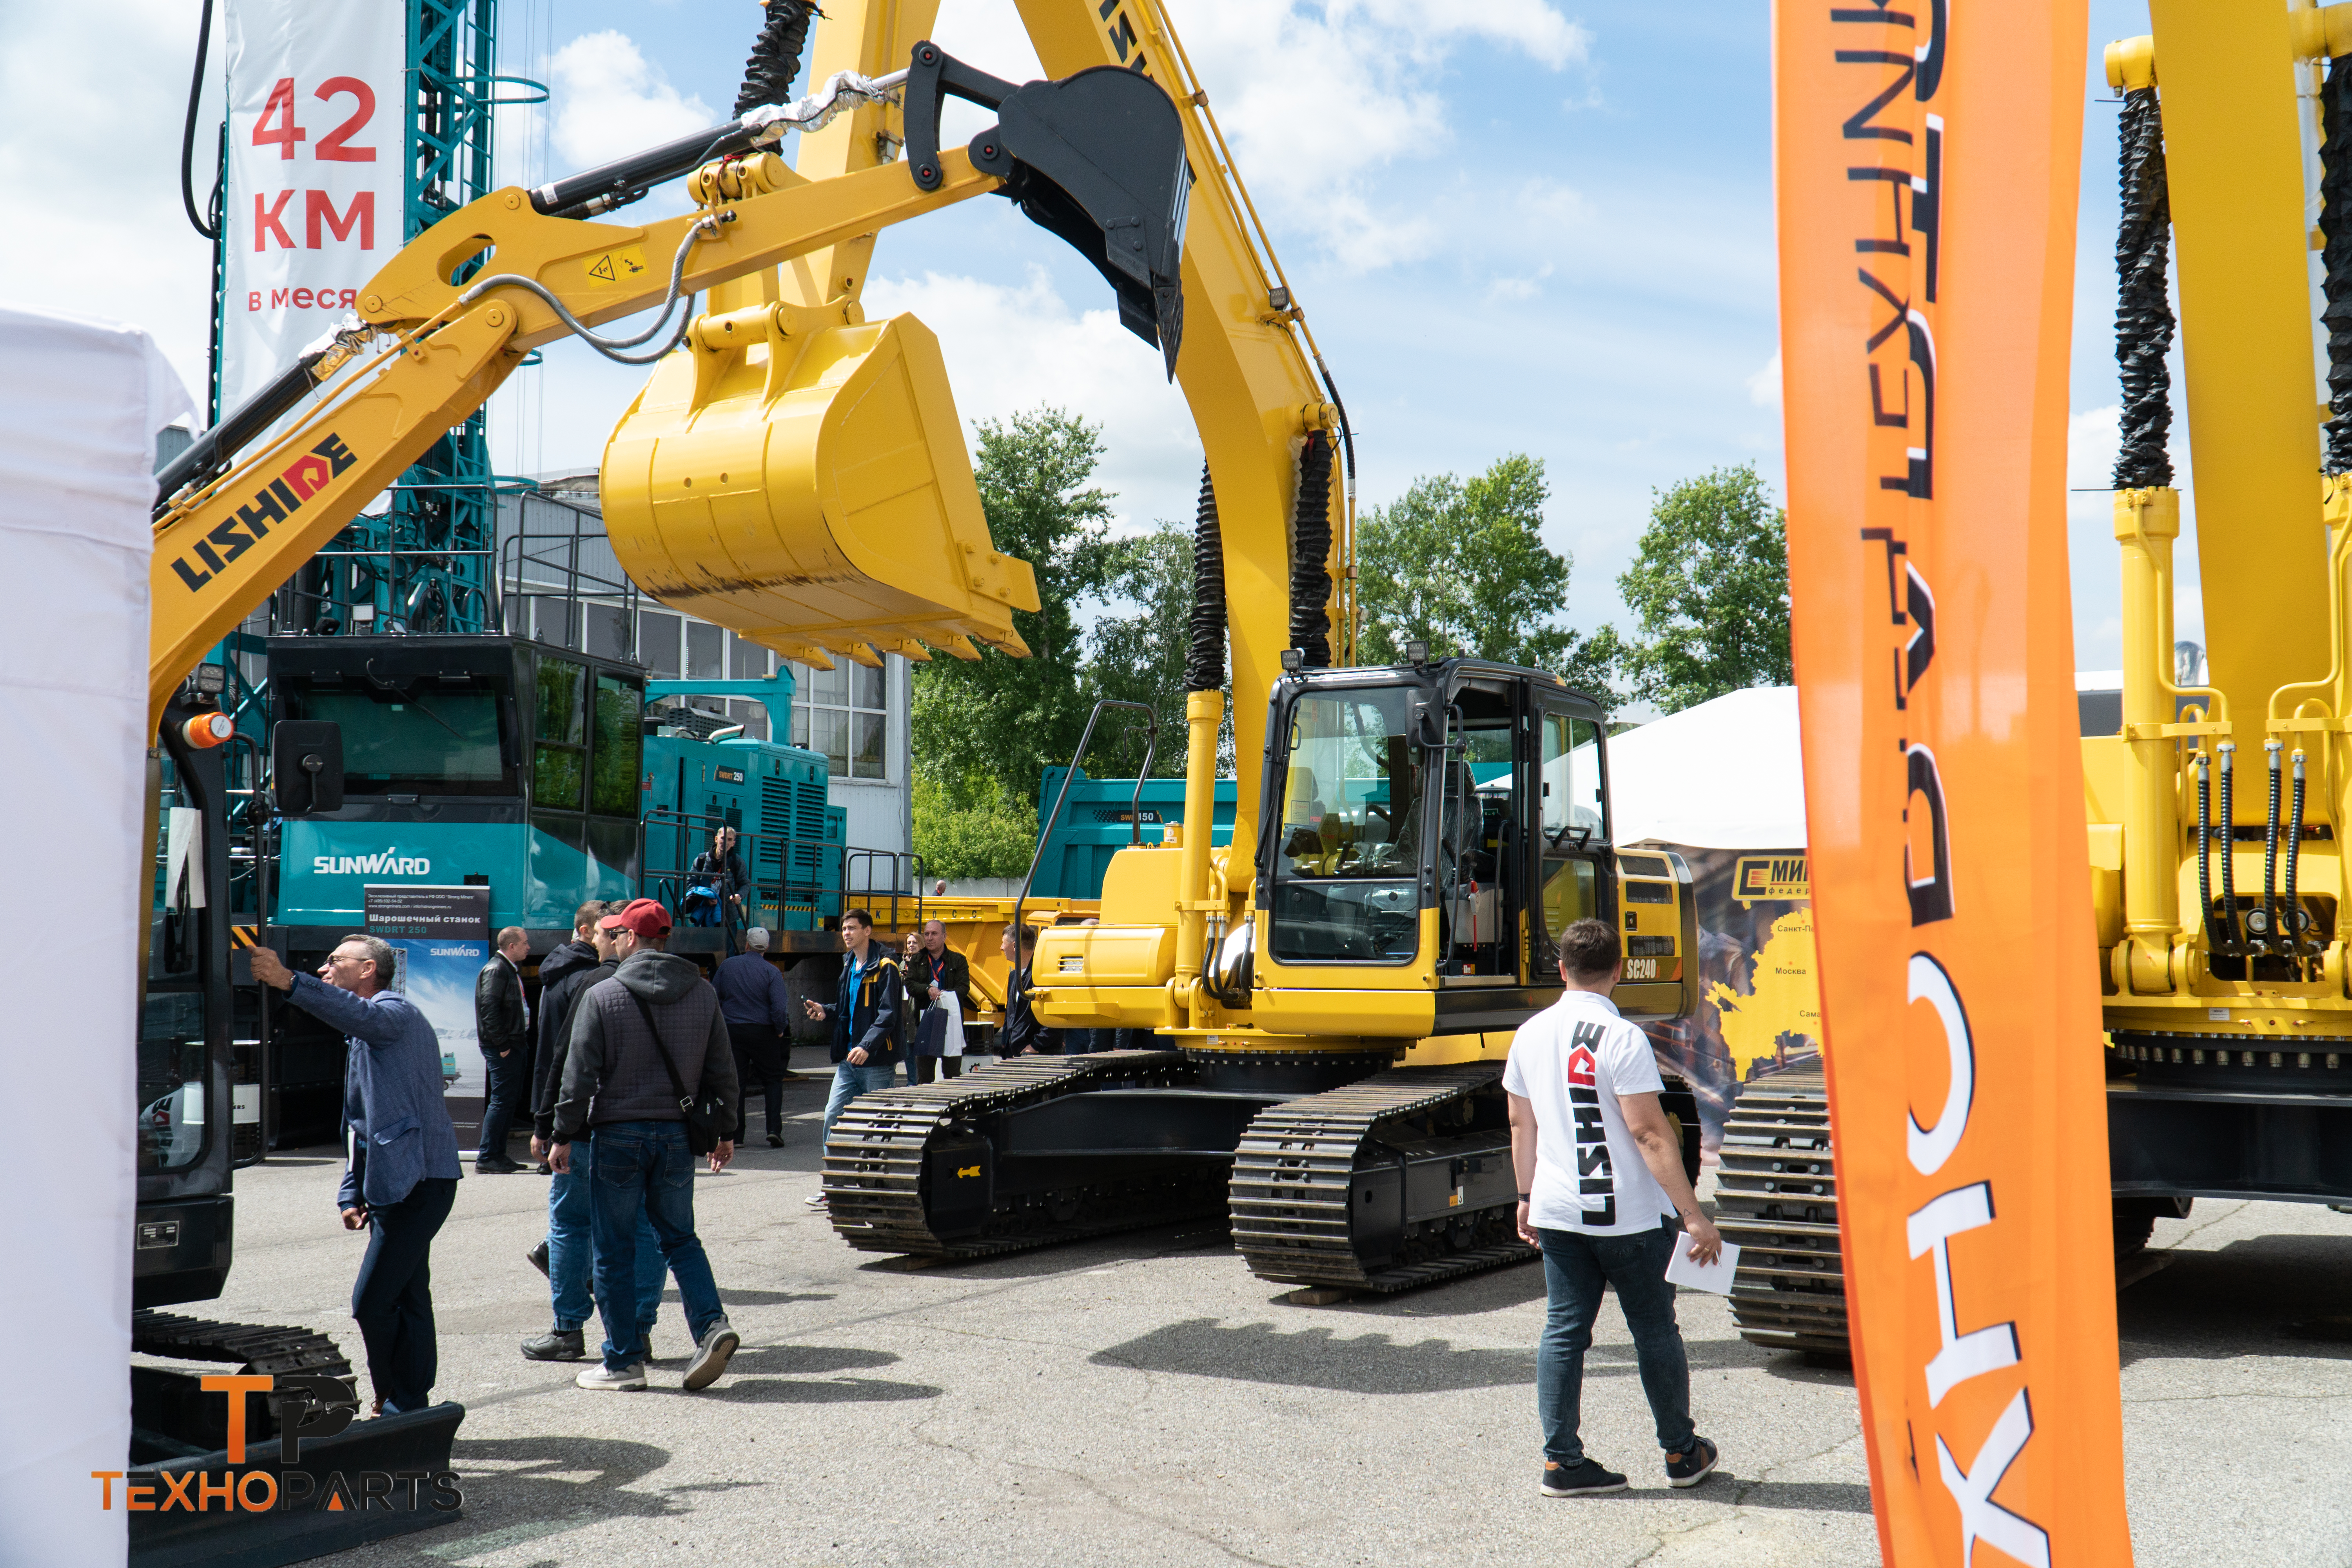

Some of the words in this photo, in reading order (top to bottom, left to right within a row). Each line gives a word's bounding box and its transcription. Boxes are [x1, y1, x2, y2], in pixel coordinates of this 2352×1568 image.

[252, 76, 376, 162] 42
[272, 287, 357, 309] меся
[171, 432, 358, 593] LISHIDE
[733, 772, 743, 781] 250
[314, 847, 430, 875] SUNWARD
[1769, 887, 1810, 895] федер
[369, 914, 441, 923] Шарошечный
[430, 944, 480, 956] SUNWARD
[1568, 1020, 1616, 1226] LISHIDE
